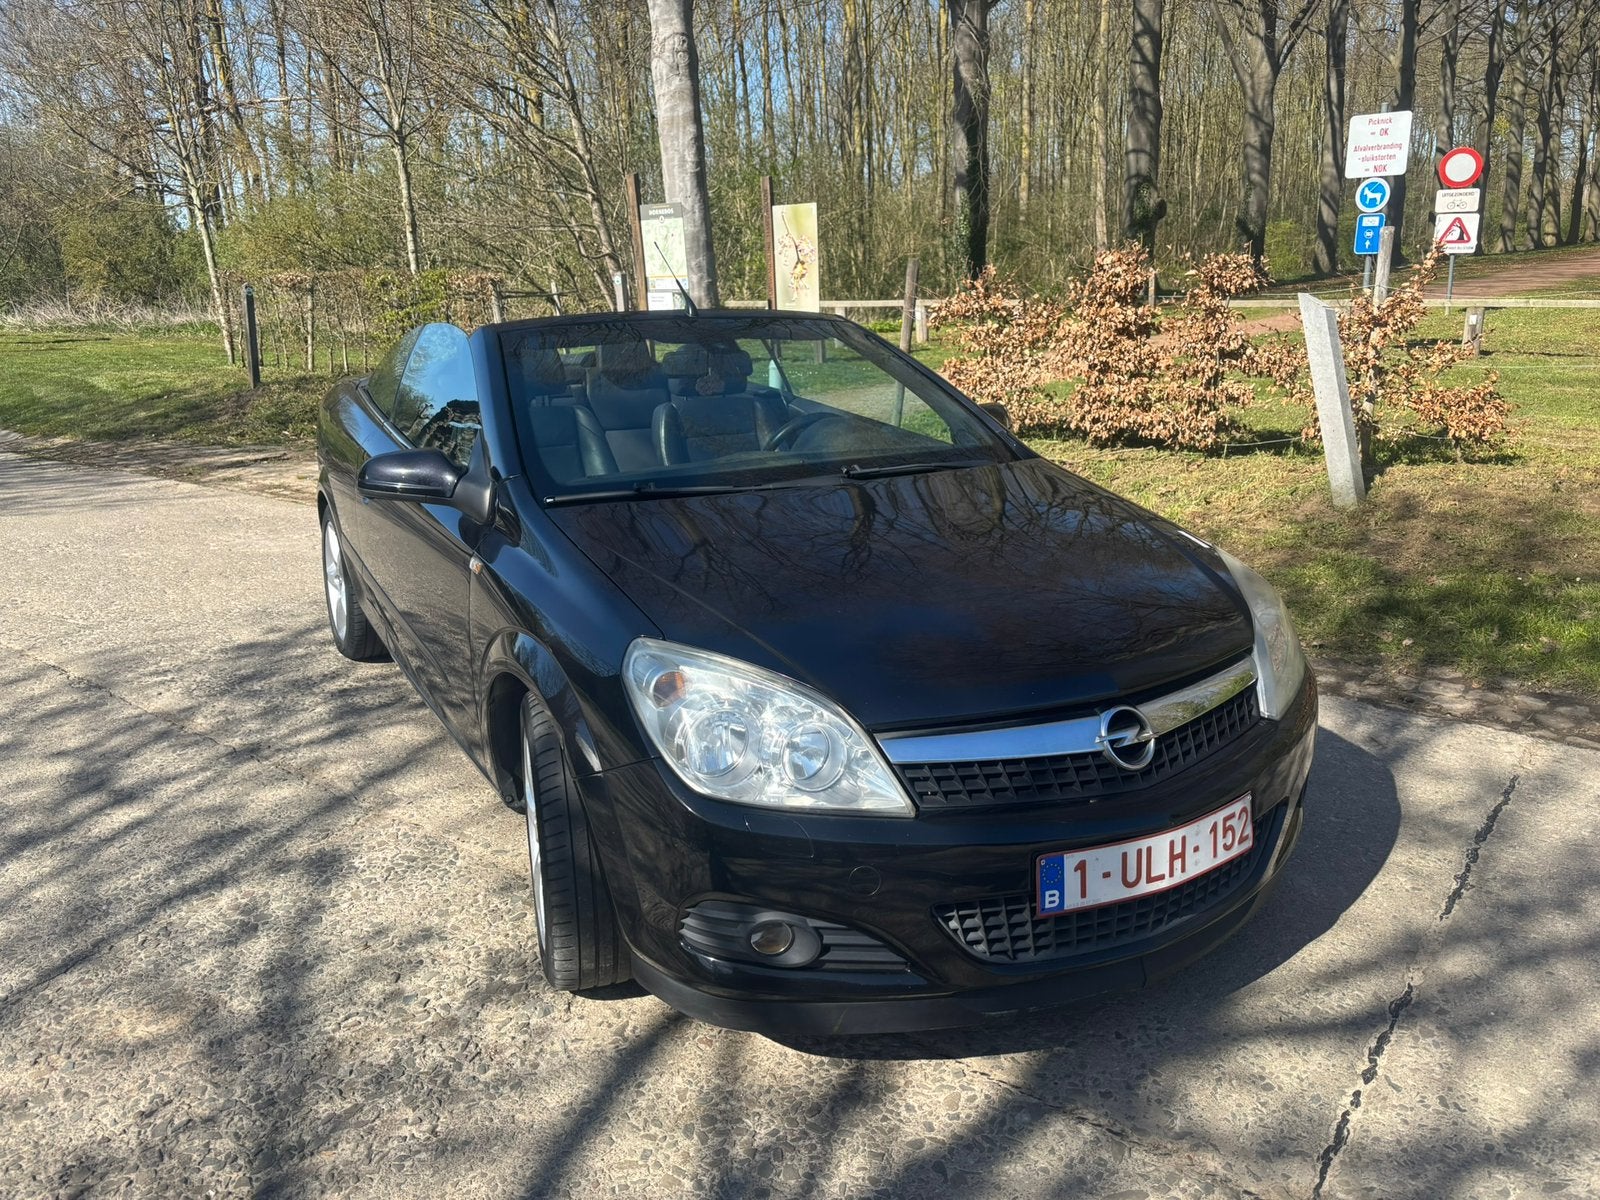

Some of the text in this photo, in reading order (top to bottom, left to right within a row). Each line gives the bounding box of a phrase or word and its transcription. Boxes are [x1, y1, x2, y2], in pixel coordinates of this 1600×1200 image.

[1368, 116, 1393, 126] Picknick
[1379, 127, 1390, 137] OK
[1353, 142, 1403, 153] Afvalverbranding
[1373, 163, 1388, 173] NOK
[1044, 889, 1060, 909] B
